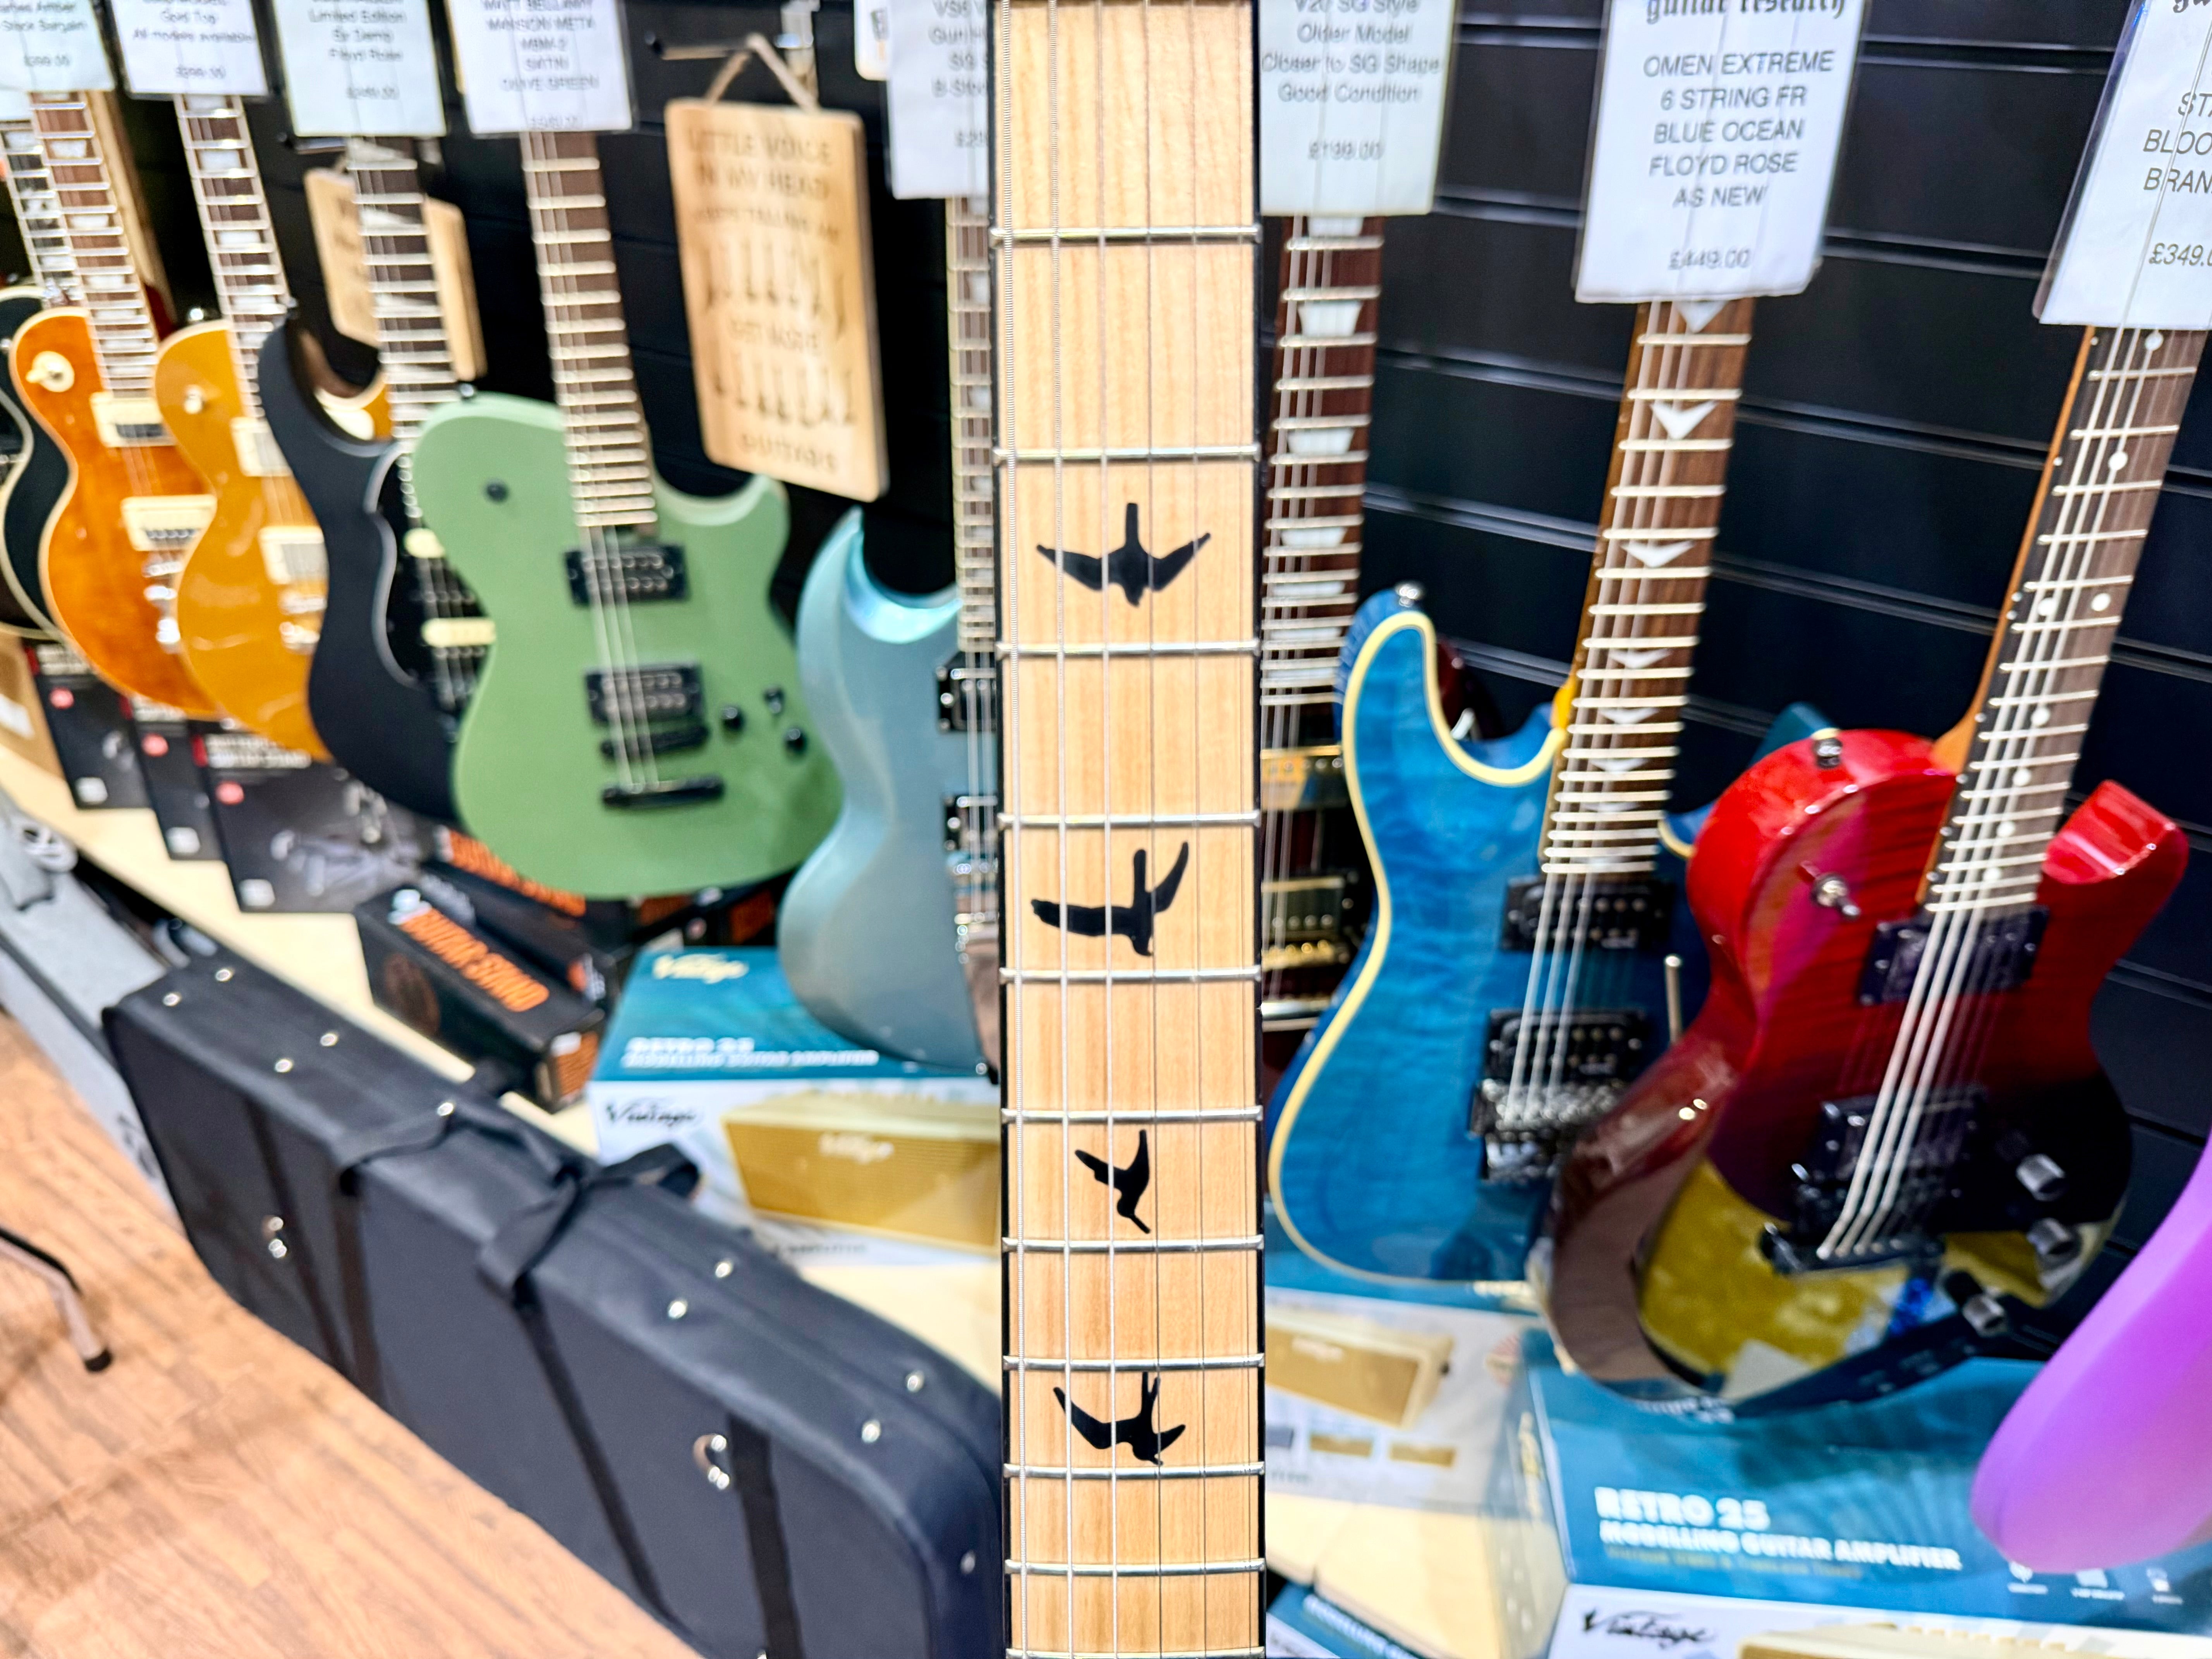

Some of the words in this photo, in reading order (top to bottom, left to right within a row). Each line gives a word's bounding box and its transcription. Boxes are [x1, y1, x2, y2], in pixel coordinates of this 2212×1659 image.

[1297, 22, 1350, 43] Older
[1355, 23, 1411, 44] Model
[1262, 51, 1320, 72] Closer
[1326, 53, 1345, 73] to
[1348, 54, 1379, 74] SG
[1384, 54, 1440, 79] Shape
[1644, 55, 1714, 77] OMEN
[1721, 50, 1836, 75] EXTREME
[1279, 80, 1329, 103] Good
[1334, 81, 1419, 103] Condition
[1660, 90, 1674, 110] 6
[1680, 87, 1770, 110] STRING
[1776, 85, 1808, 107] FR
[2178, 92, 2212, 117] ST
[1654, 120, 1715, 143] BLUE
[1722, 118, 1805, 142] OCEAN
[766, 132, 833, 165] VOICE
[1648, 155, 1728, 176] FLOYD
[1733, 153, 1799, 174] ROSE
[766, 167, 830, 201] HEAD
[2143, 168, 2212, 194] BRAN
[1673, 187, 1704, 208] AS
[1711, 185, 1767, 207] NEW
[1668, 249, 1751, 270] £449.00
[1594, 1486, 1715, 1527] RETRO
[1716, 1497, 1771, 1531] 25
[1599, 1520, 1741, 1554] MODELLING
[1741, 1531, 1832, 1561] GUITAR
[1834, 1539, 1963, 1571] AMPLIFIER
[1583, 1607, 1718, 1650] Vintage
